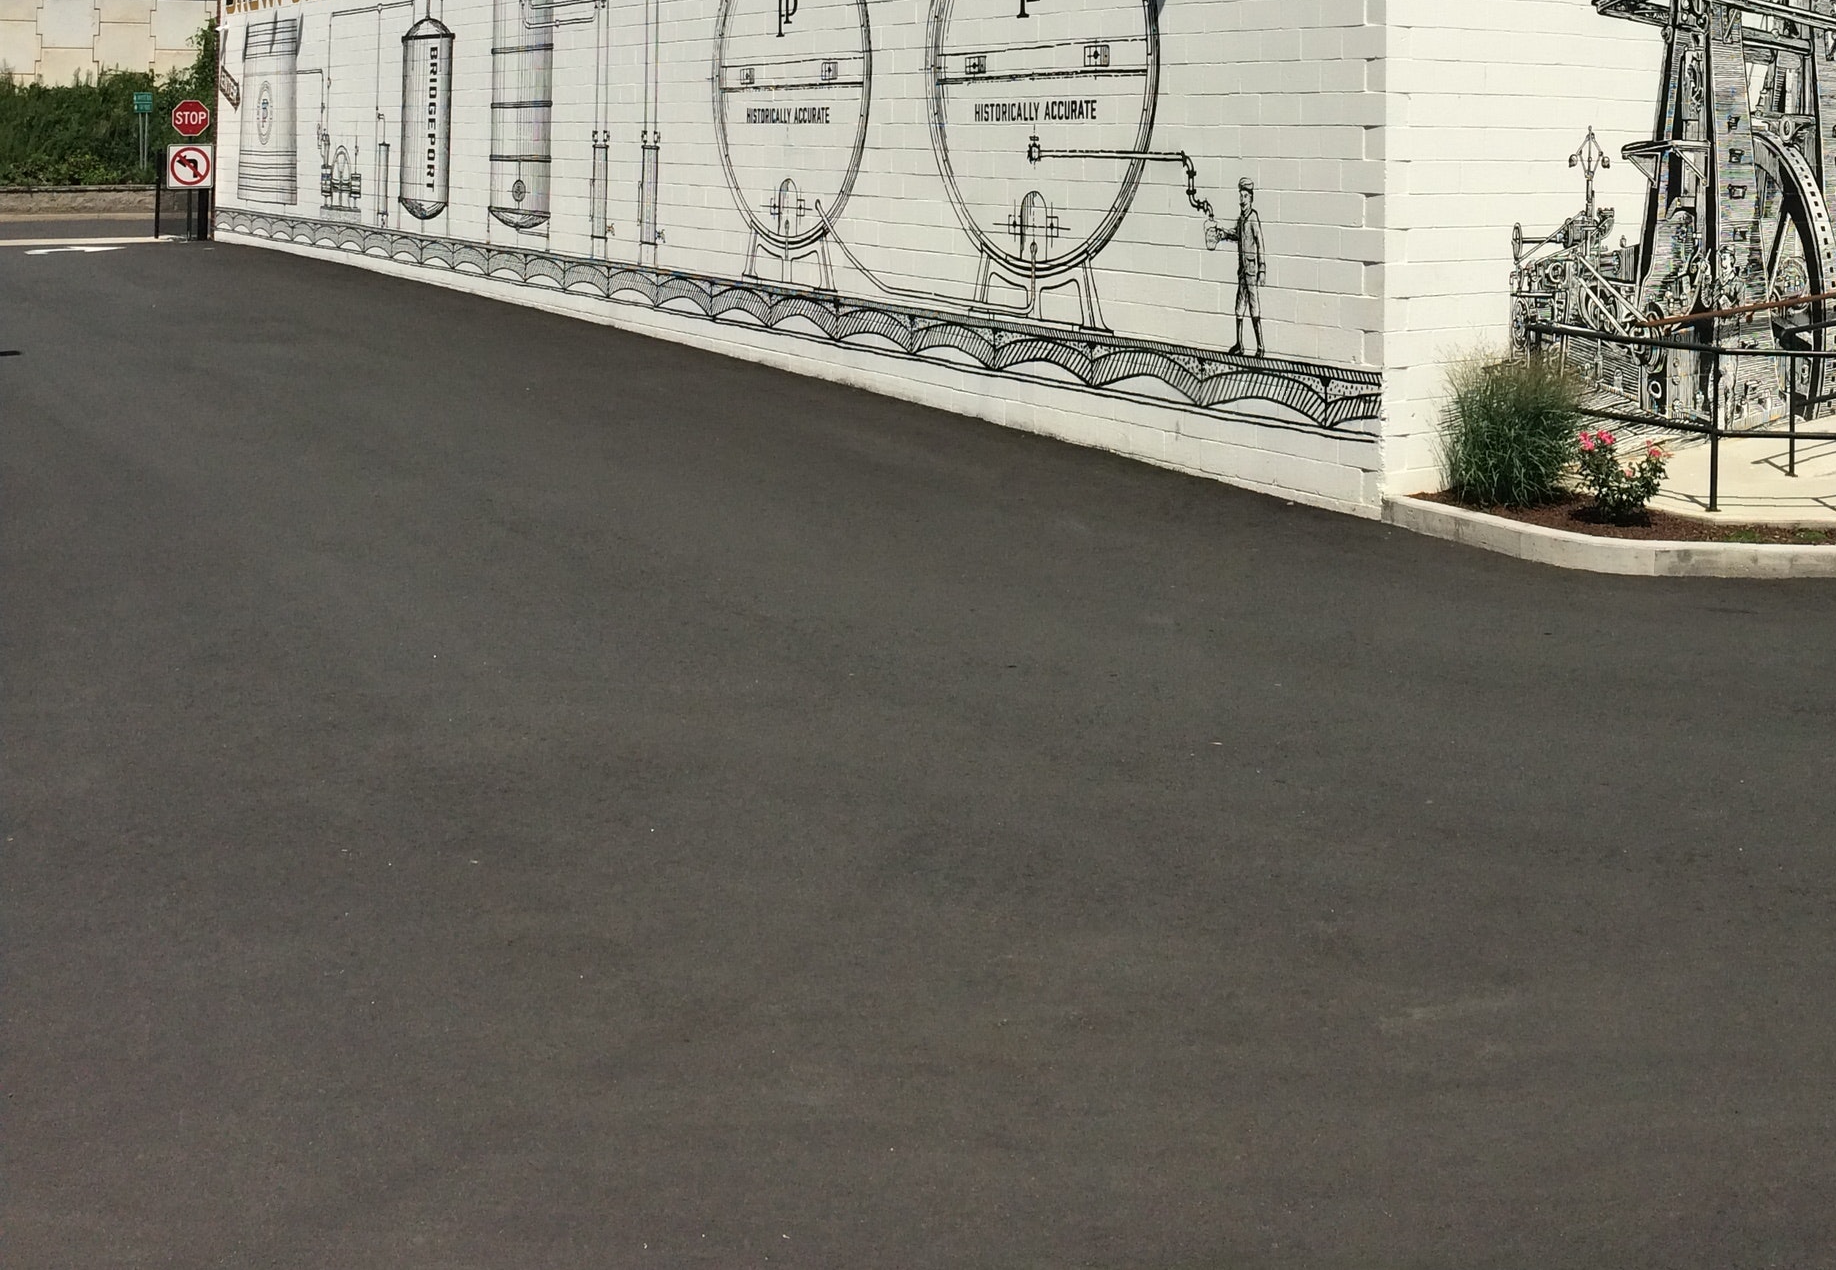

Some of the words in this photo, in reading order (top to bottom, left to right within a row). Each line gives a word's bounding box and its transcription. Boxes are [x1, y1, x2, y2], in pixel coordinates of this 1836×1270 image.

[175, 112, 207, 125] STOP
[426, 47, 438, 192] BRIDGEPORT
[747, 108, 792, 123] HISTORICALLY
[794, 107, 830, 123] ACCURATE
[975, 102, 1040, 122] HISTORICALLY
[1044, 100, 1097, 121] ACCURATE
